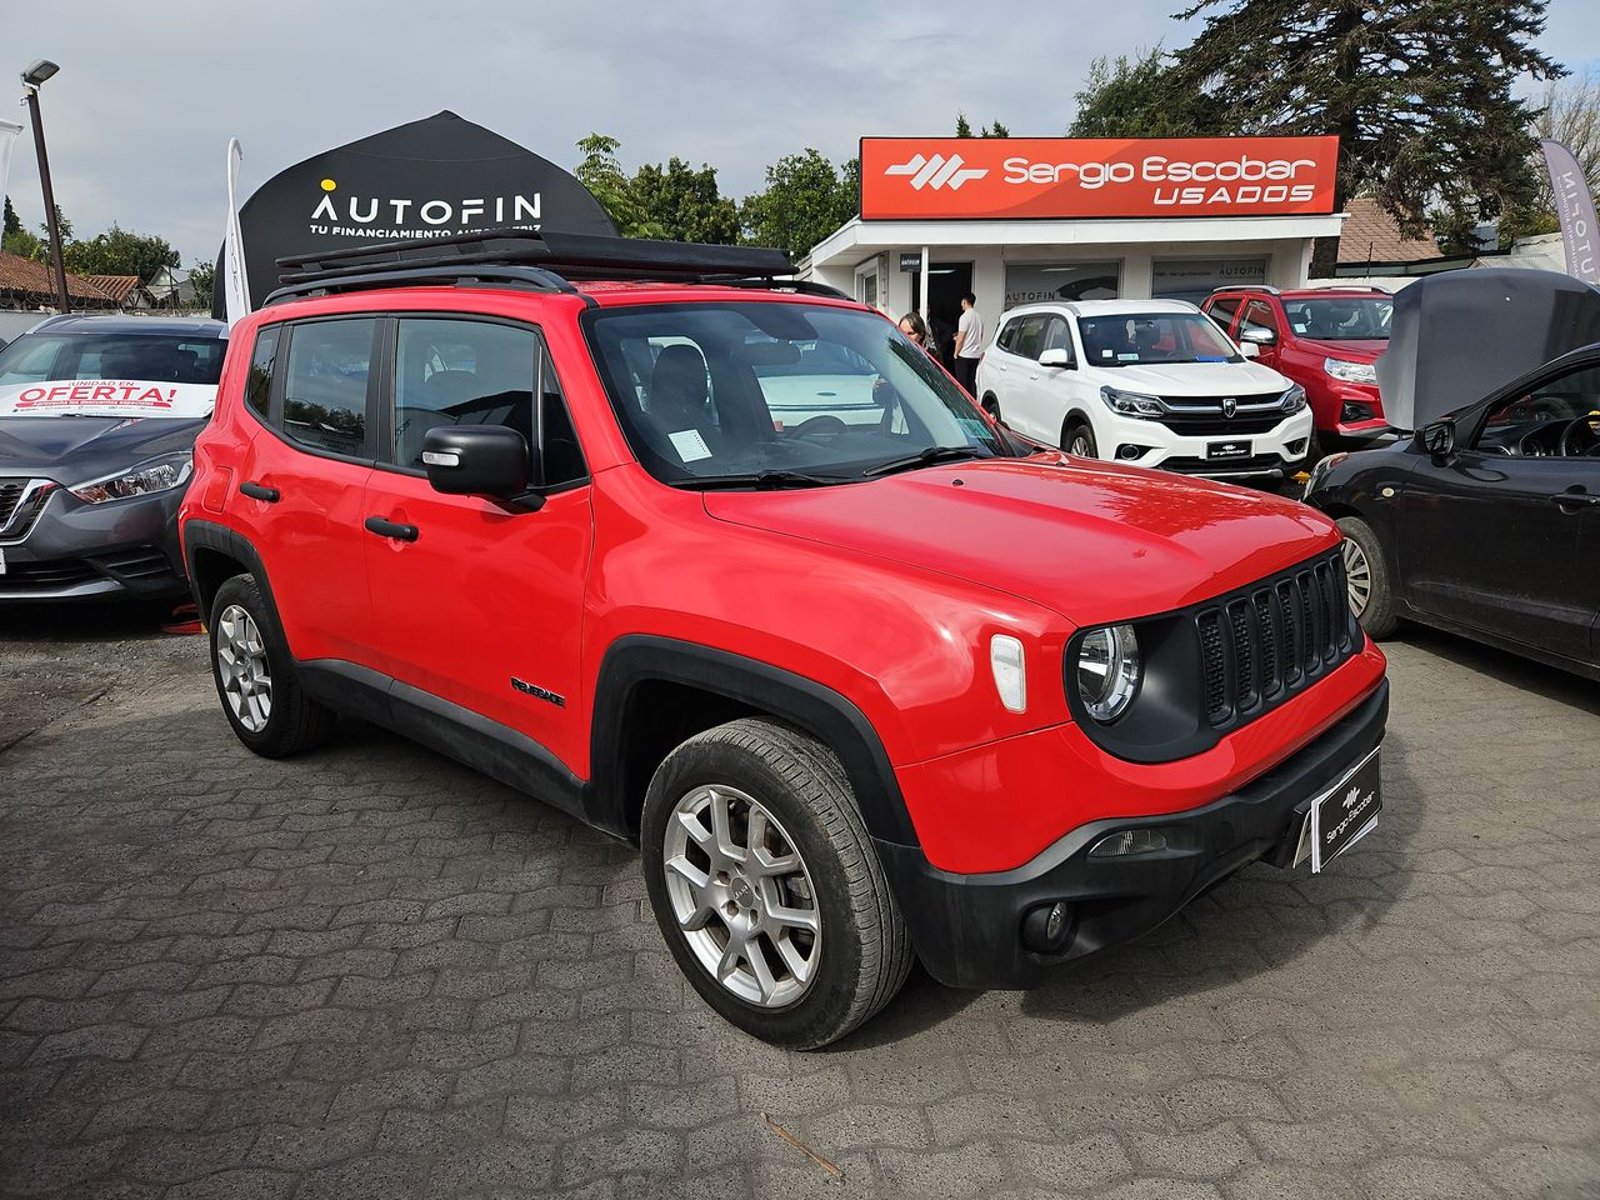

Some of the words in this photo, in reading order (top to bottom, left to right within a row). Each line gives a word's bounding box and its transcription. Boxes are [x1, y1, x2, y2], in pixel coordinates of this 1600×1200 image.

[1003, 157, 1135, 189] Sergio
[1142, 155, 1317, 182] Escobar
[1153, 185, 1315, 205] USADOS
[311, 193, 541, 225] AUTOFIN
[310, 225, 328, 235] TU
[332, 227, 452, 239] FINANCIAMIENTO
[19, 386, 177, 402] OFERTA!
